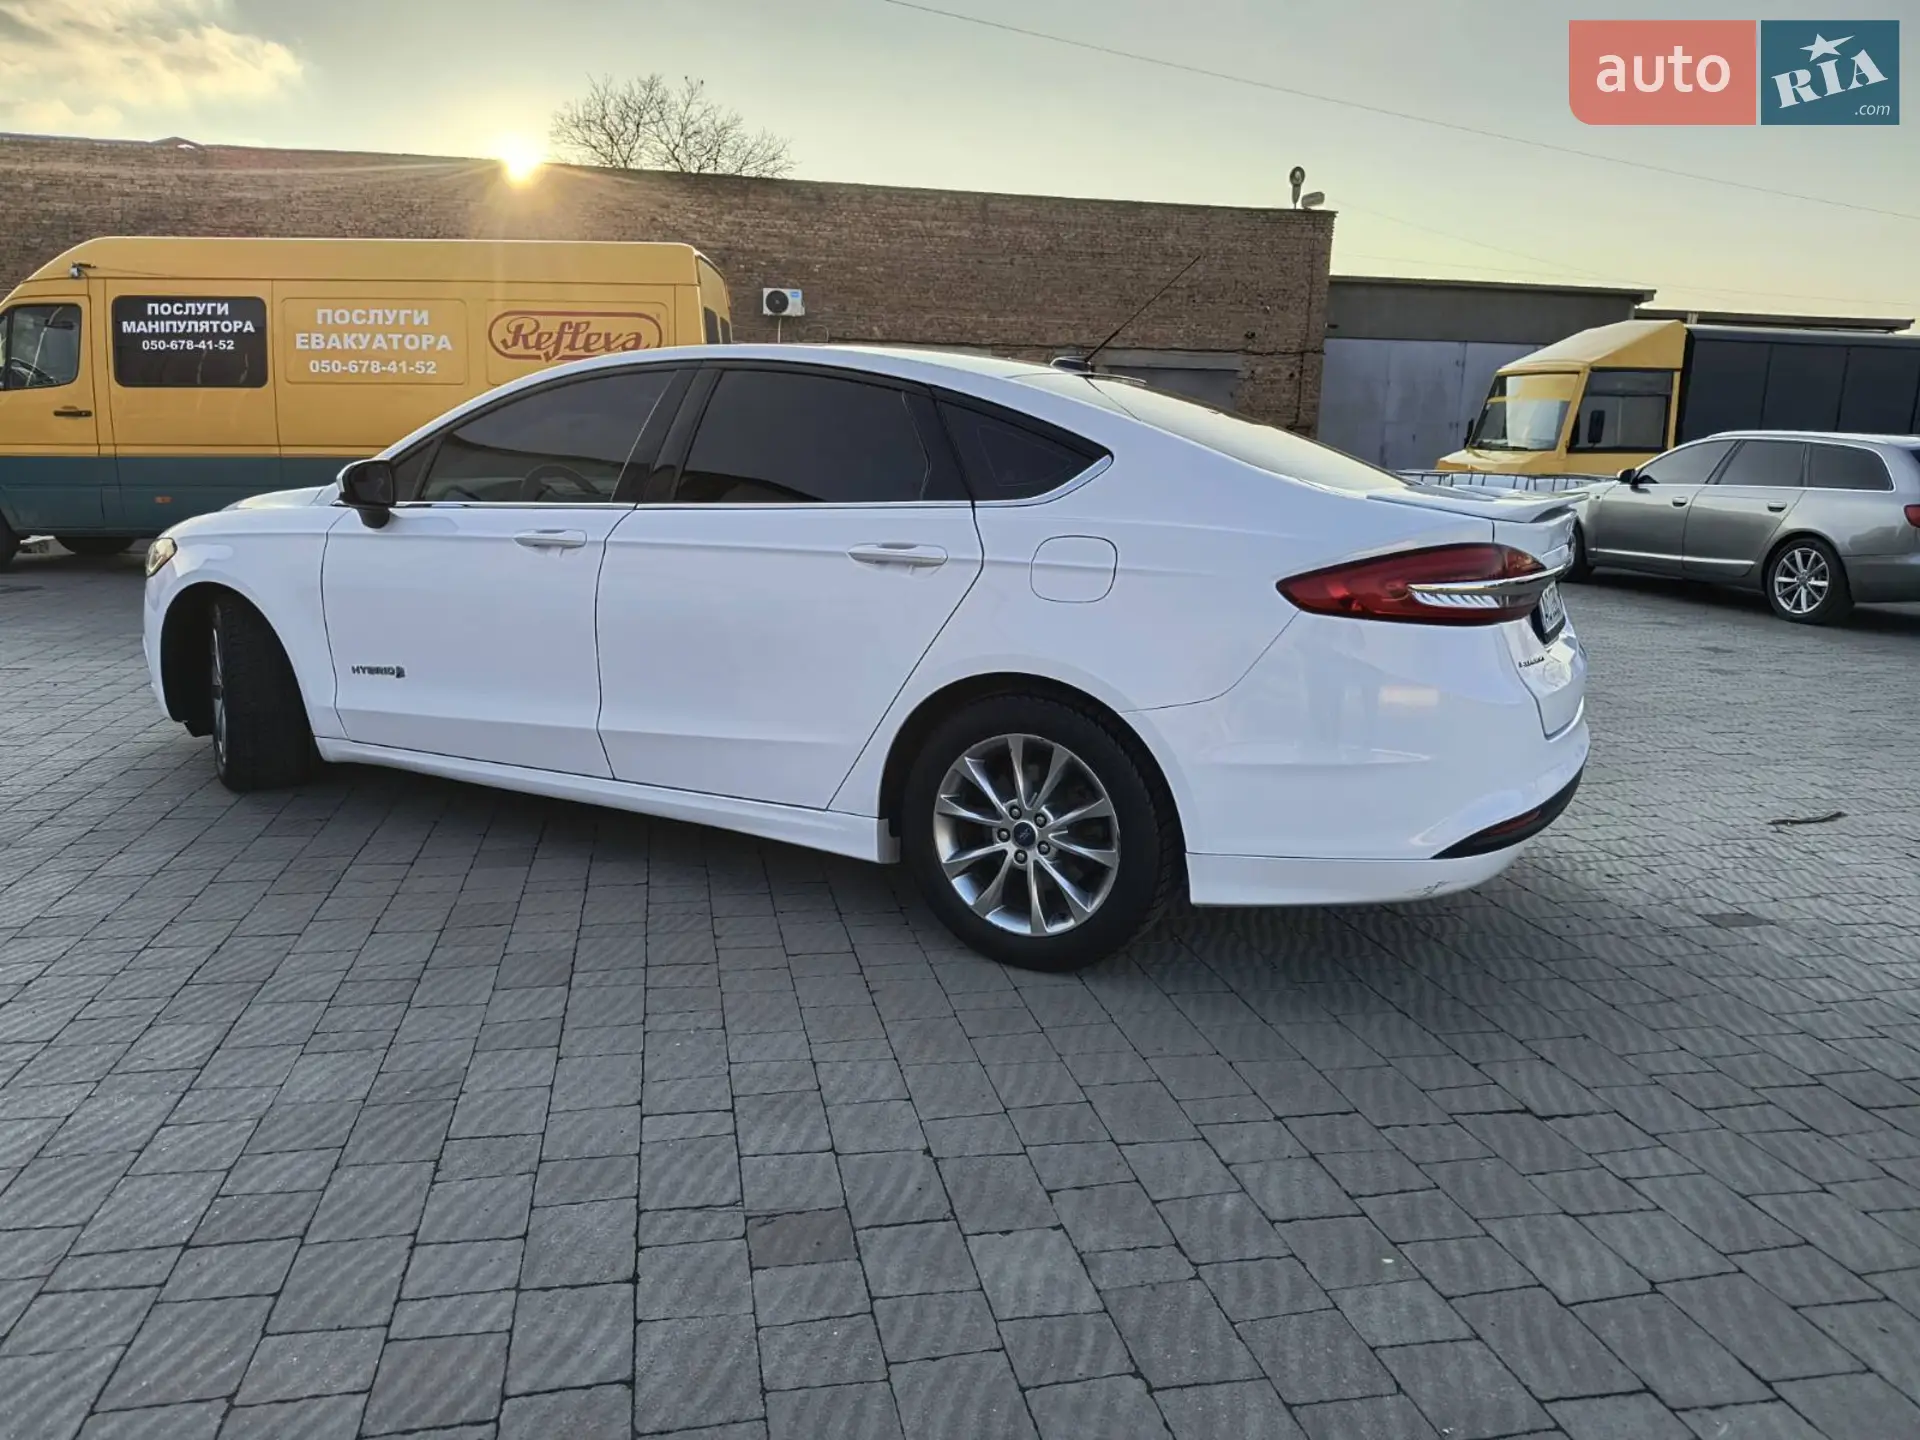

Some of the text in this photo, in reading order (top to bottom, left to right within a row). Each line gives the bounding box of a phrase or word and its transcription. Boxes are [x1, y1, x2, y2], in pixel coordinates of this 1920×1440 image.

[146, 302, 229, 316] ПОСЛУГИ
[316, 308, 430, 326] ПОСЛУГИ
[121, 320, 256, 334] МАНІПУЛЯТОРА
[141, 339, 235, 350] 050-678-41-52
[295, 333, 453, 351] ЕВАКУАТОРА
[309, 360, 437, 374] 050-678-41-52
